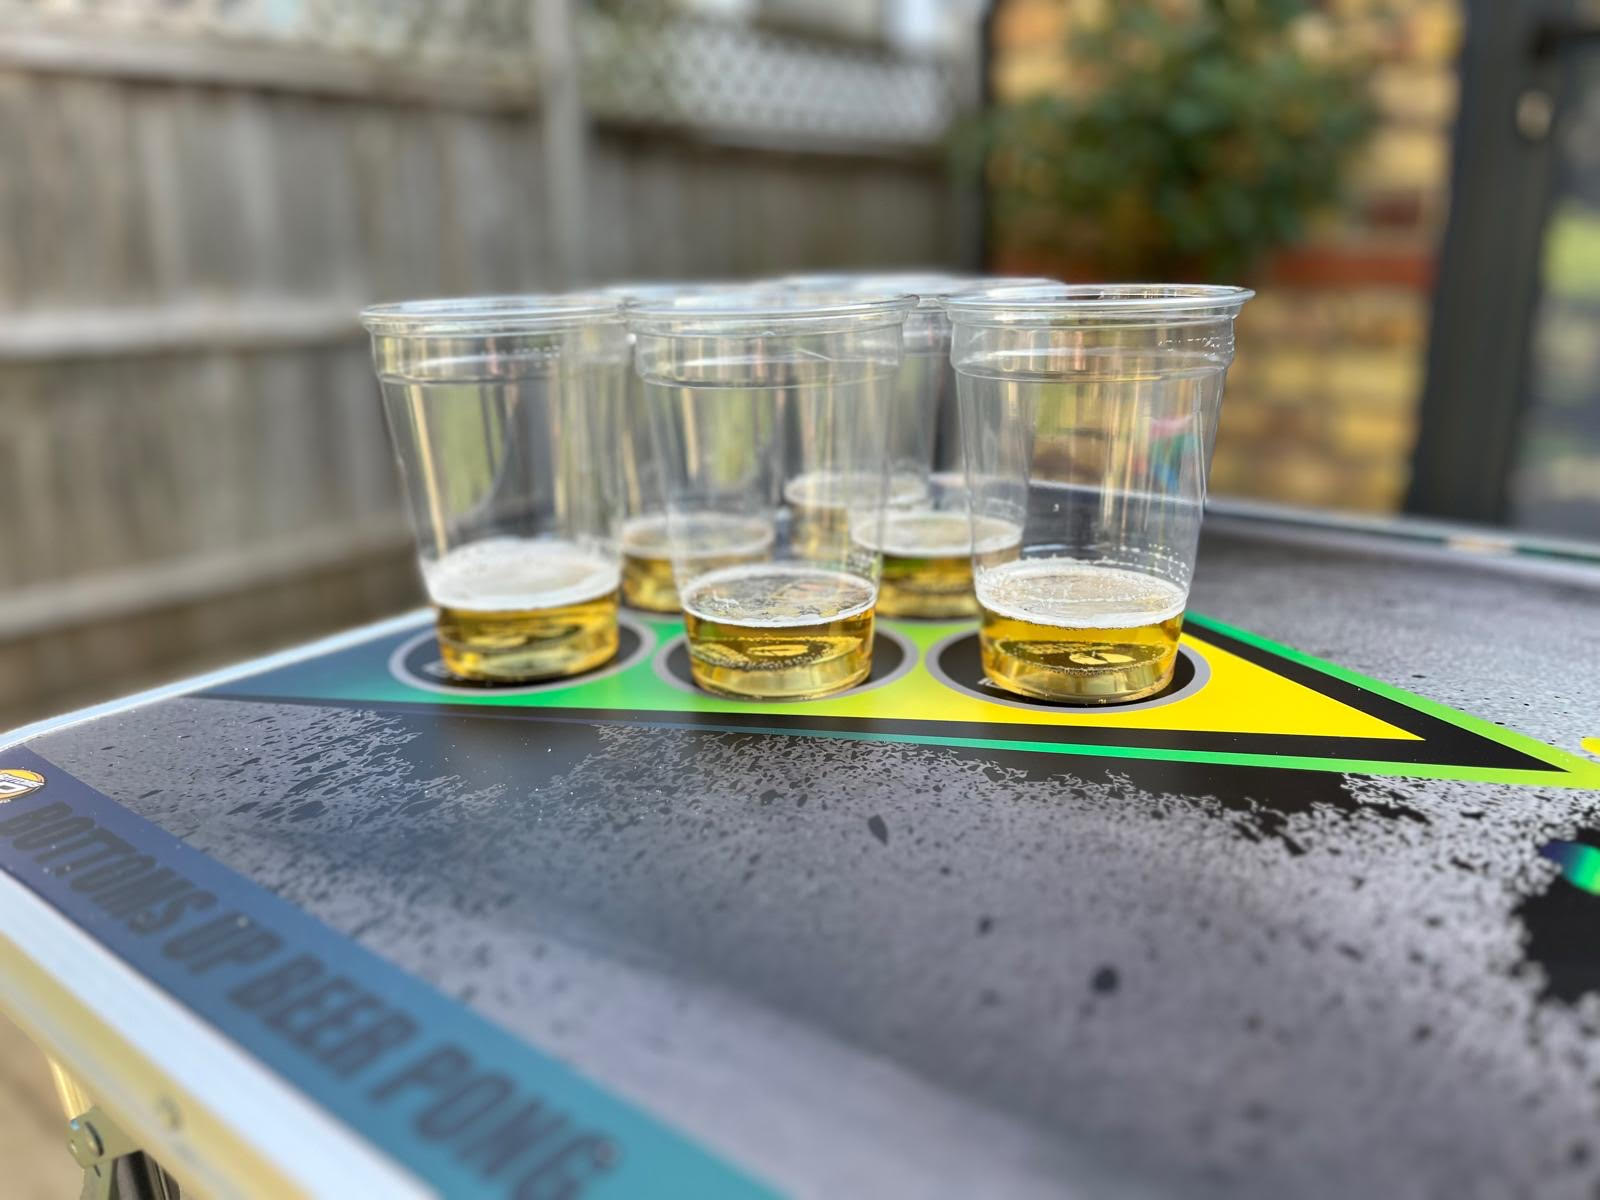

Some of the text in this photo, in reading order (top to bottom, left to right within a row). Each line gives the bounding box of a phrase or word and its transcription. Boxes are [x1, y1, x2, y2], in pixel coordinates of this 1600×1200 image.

[0, 801, 622, 1200] BOTTOMS UP BEER PONG
